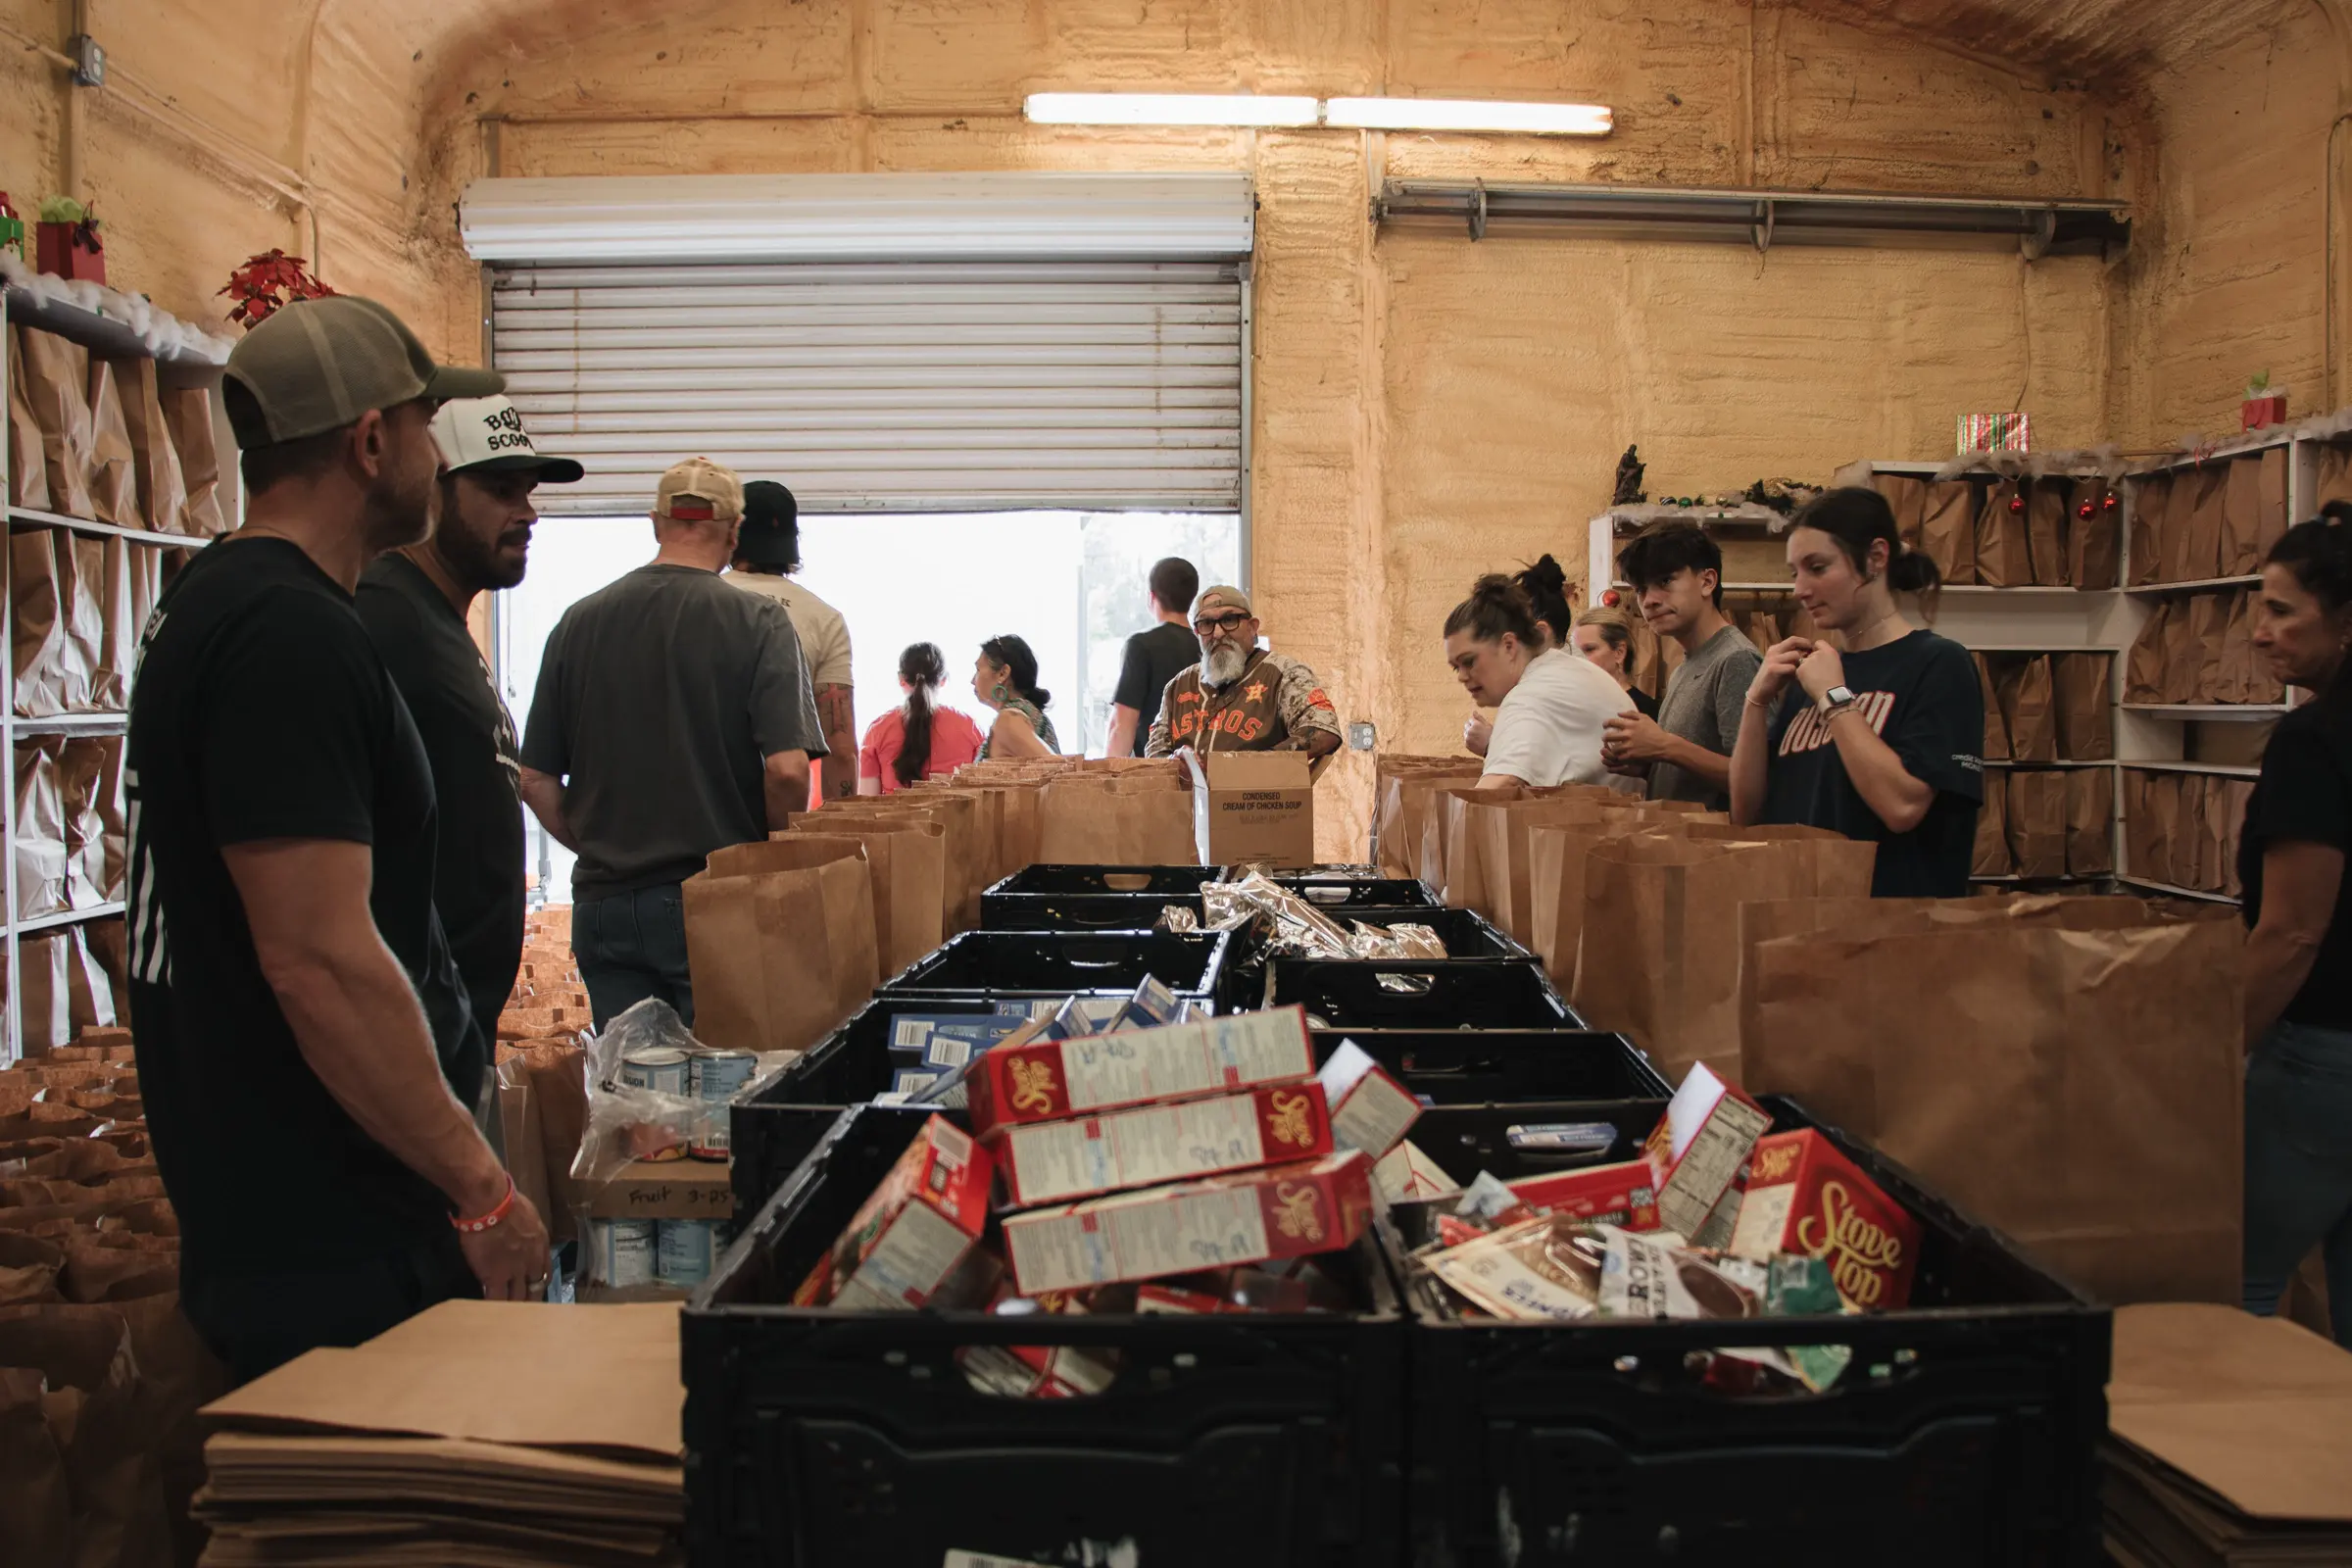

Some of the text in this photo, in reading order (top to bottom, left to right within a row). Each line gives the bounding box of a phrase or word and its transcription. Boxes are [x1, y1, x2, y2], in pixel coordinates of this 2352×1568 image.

[1222, 801, 1302, 811] CREAM OF CHICKEN SOUP
[1242, 792, 1281, 801] CONDENSED
[628, 1186, 672, 1205] Fruit
[1797, 1181, 1901, 1268] Stove
[1833, 1248, 1882, 1304] Top
